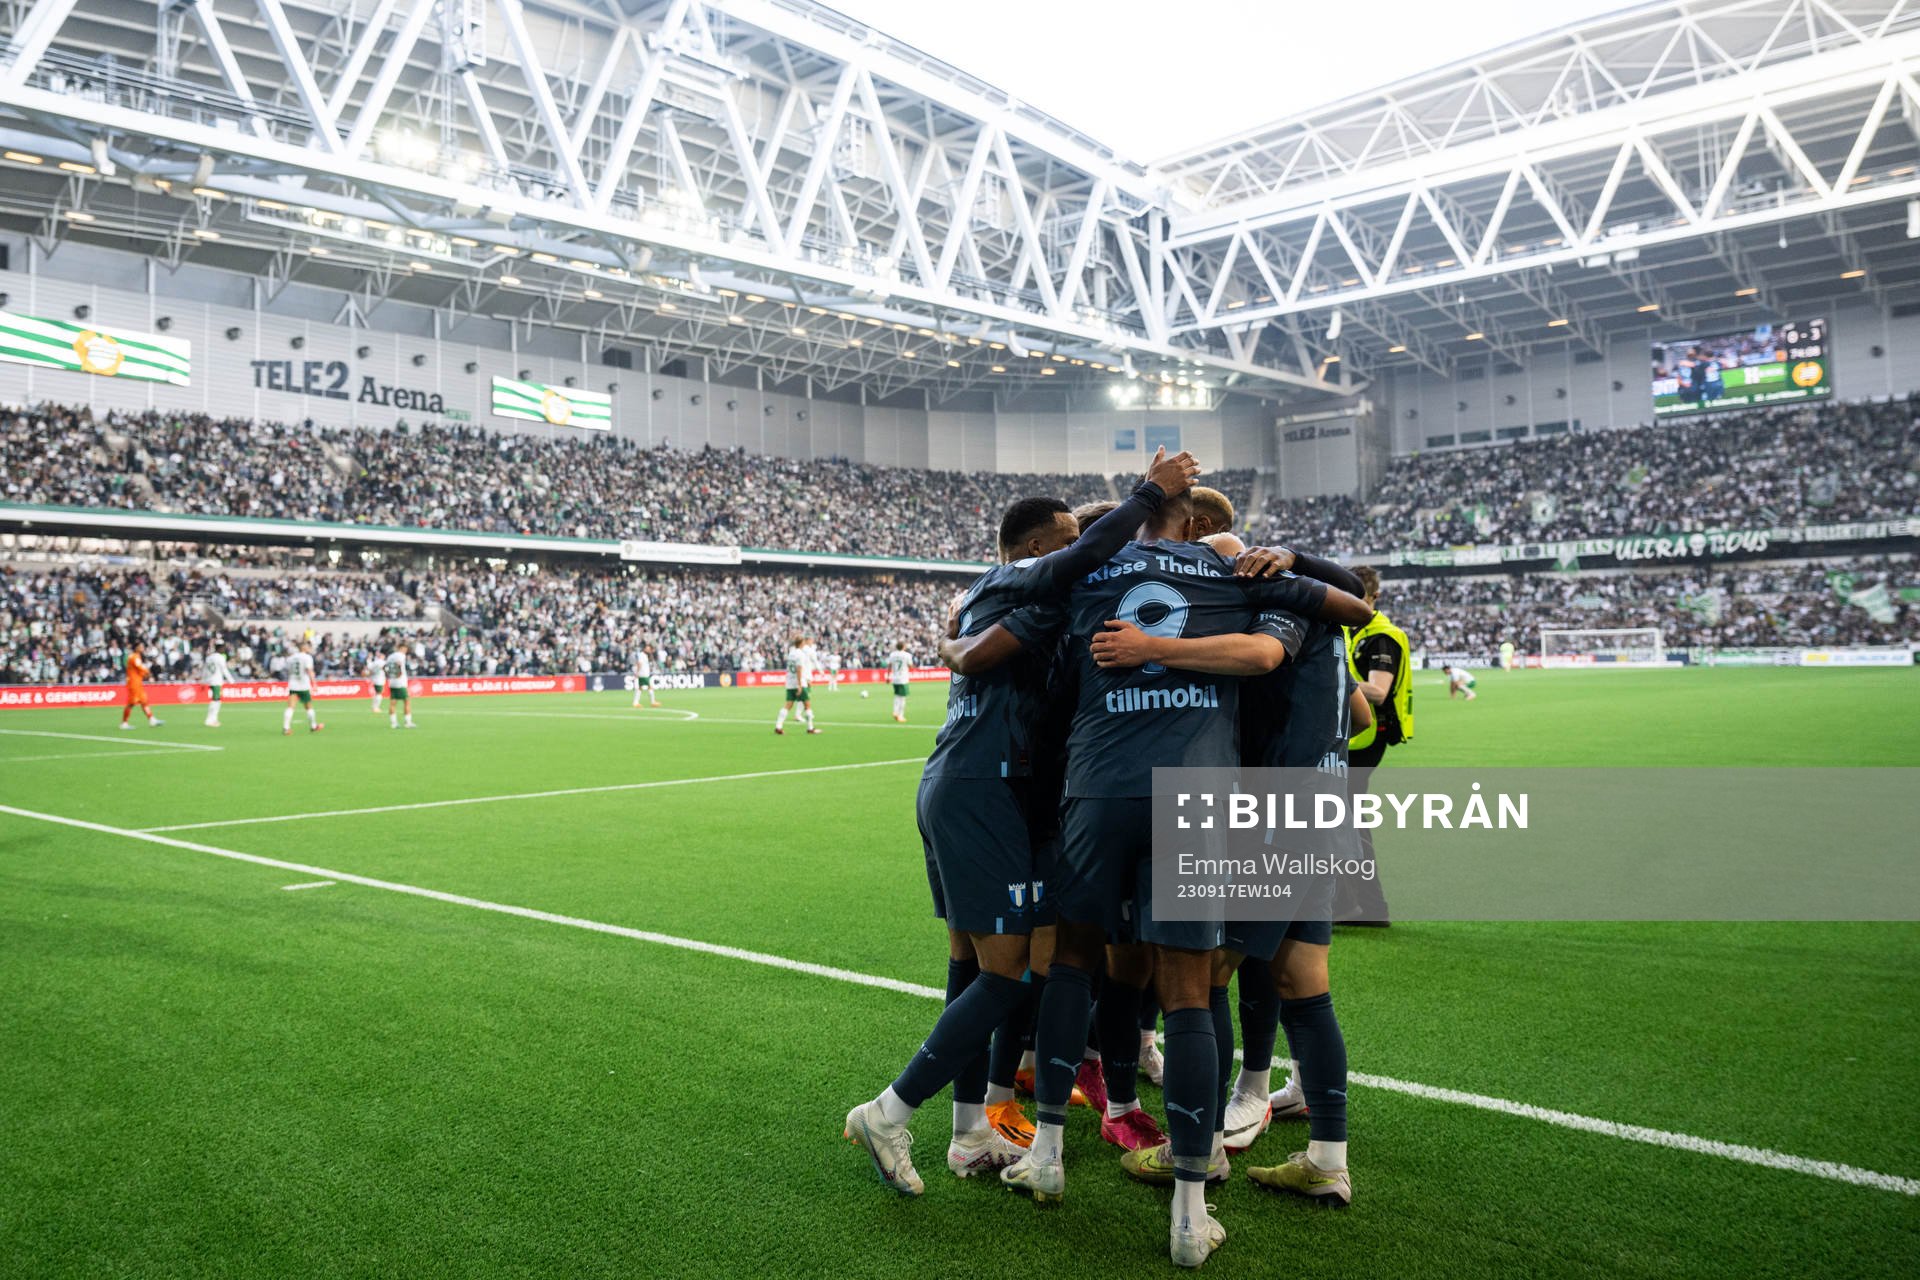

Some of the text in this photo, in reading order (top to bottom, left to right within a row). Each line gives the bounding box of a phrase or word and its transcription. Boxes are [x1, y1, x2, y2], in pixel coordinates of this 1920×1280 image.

[250, 360, 445, 414] TELE2 Arena
[624, 673, 705, 690] STCKHOLM
[0, 691, 31, 704] ÄDJE
[1105, 683, 1219, 713] tillmobil
